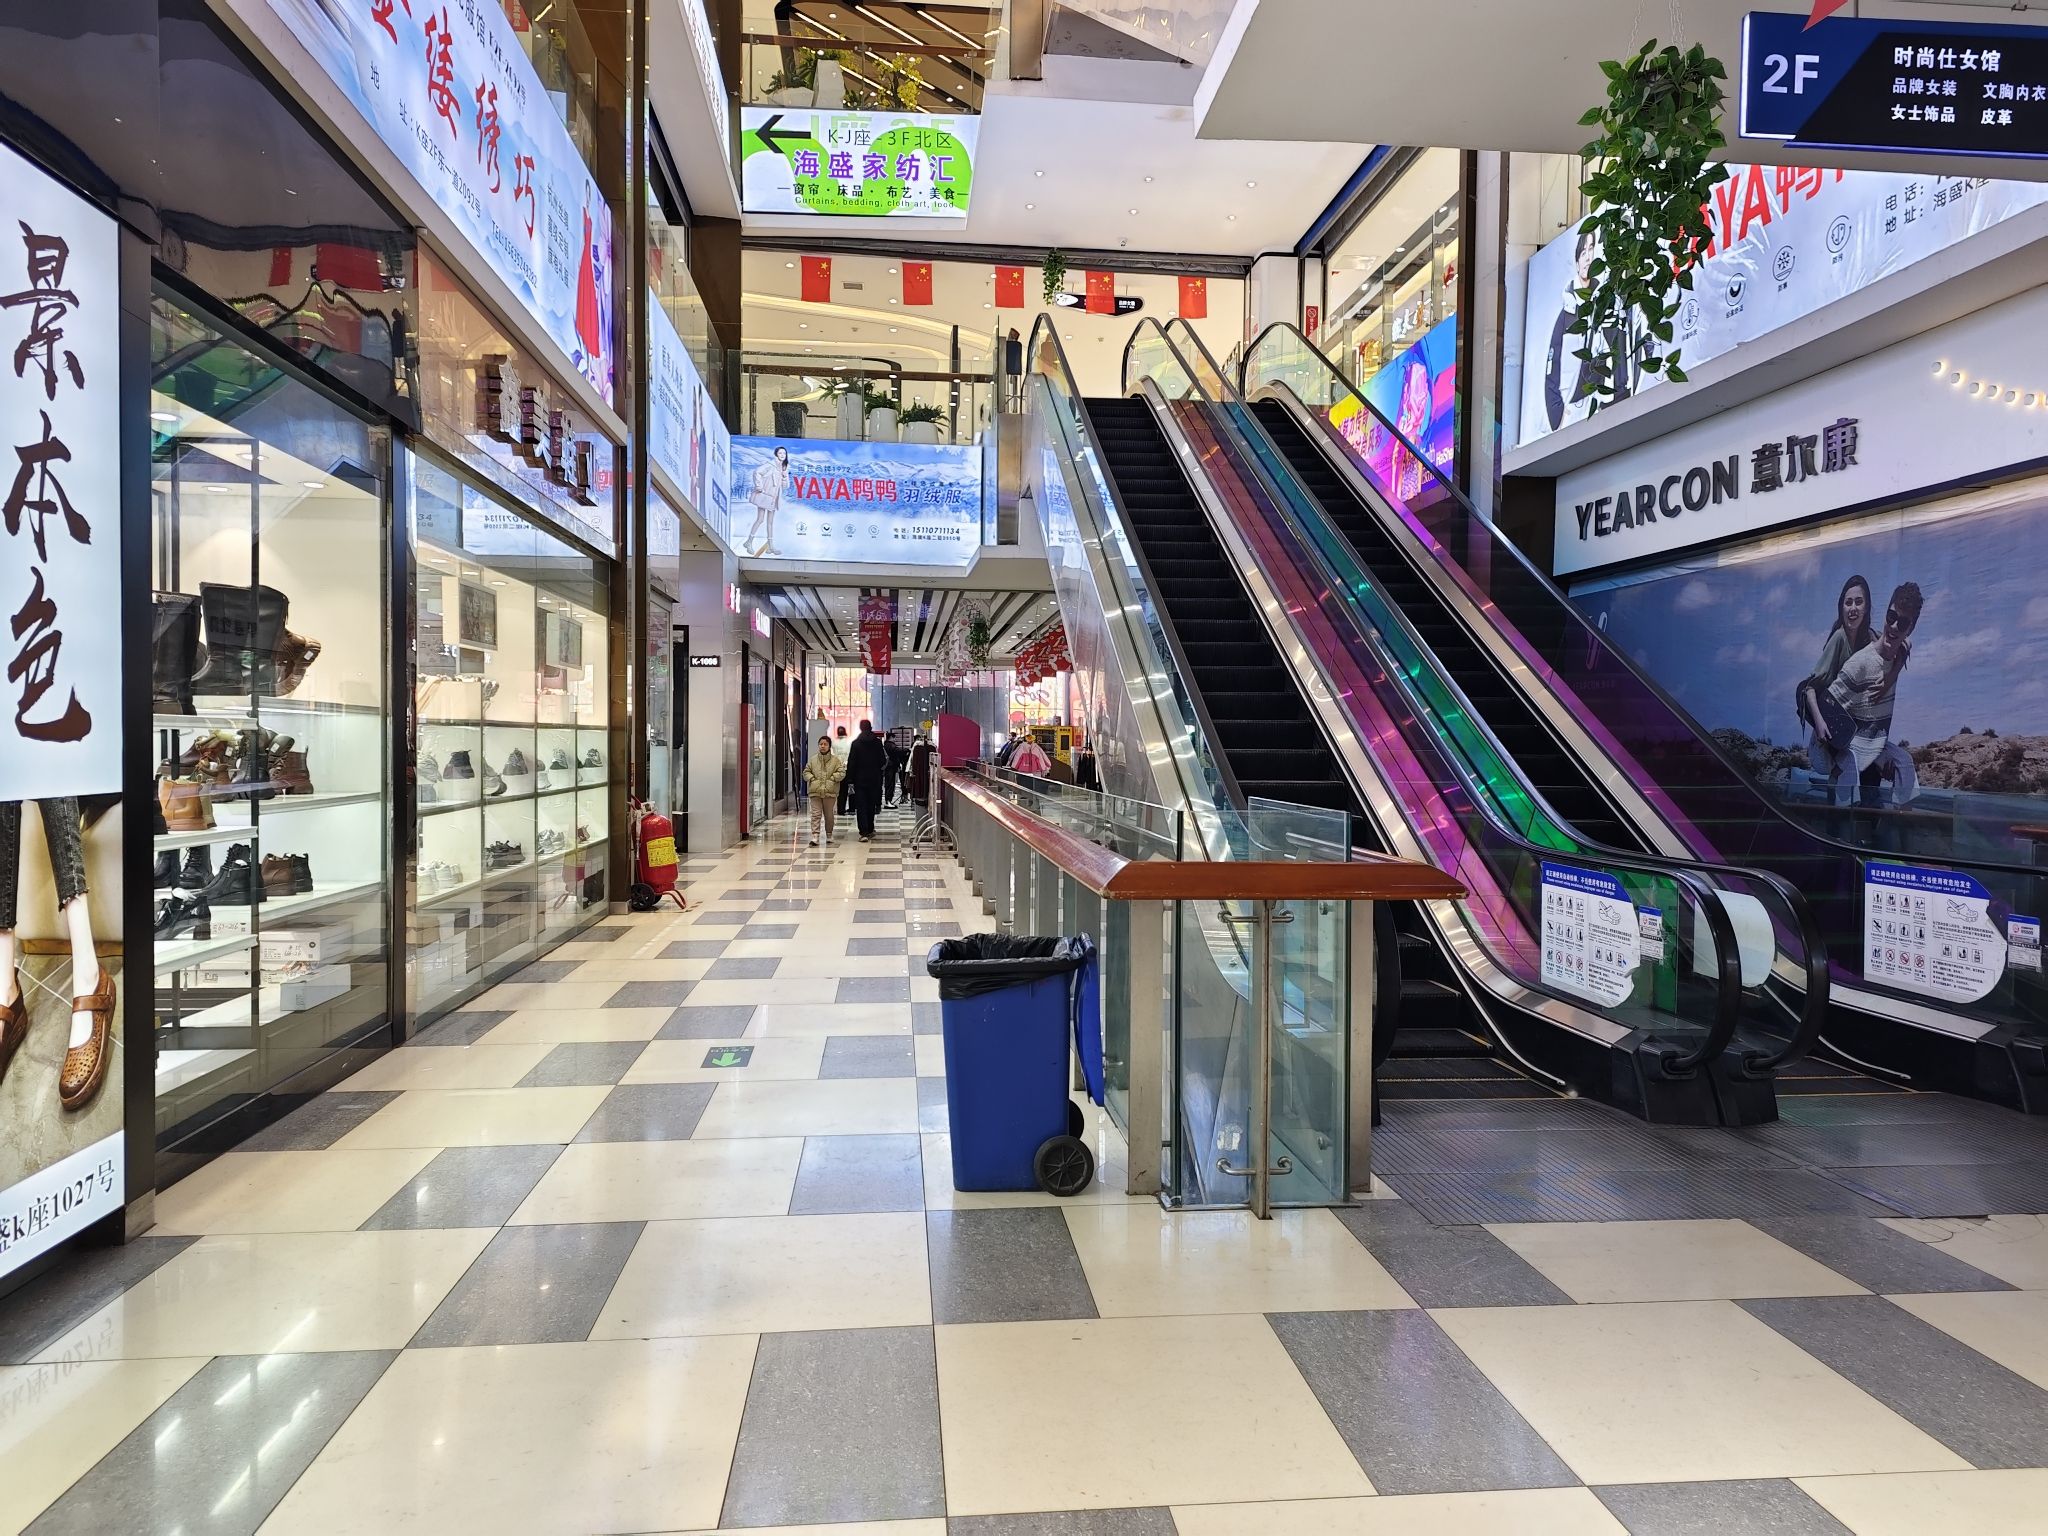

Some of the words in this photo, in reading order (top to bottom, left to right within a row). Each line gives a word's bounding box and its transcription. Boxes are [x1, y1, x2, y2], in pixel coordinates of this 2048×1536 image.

[1894, 46, 2001, 73] 时尚仕女馆
[1762, 53, 1820, 95] 2F
[1892, 77, 1958, 98] 品牌女装
[1982, 82, 2047, 102] 文胸内衣
[1891, 103, 1956, 124] 女士饰品
[1980, 108, 2013, 127] 皮革
[793, 149, 955, 183] 海盛家纺汇
[795, 197, 839, 206] Curtains,
[843, 198, 883, 208] bedding,
[0, 219, 93, 742] 景本色
[1575, 454, 1739, 541] YEARCON
[1750, 417, 1858, 494] 意尔康
[903, 488, 962, 504] 羽绒服
